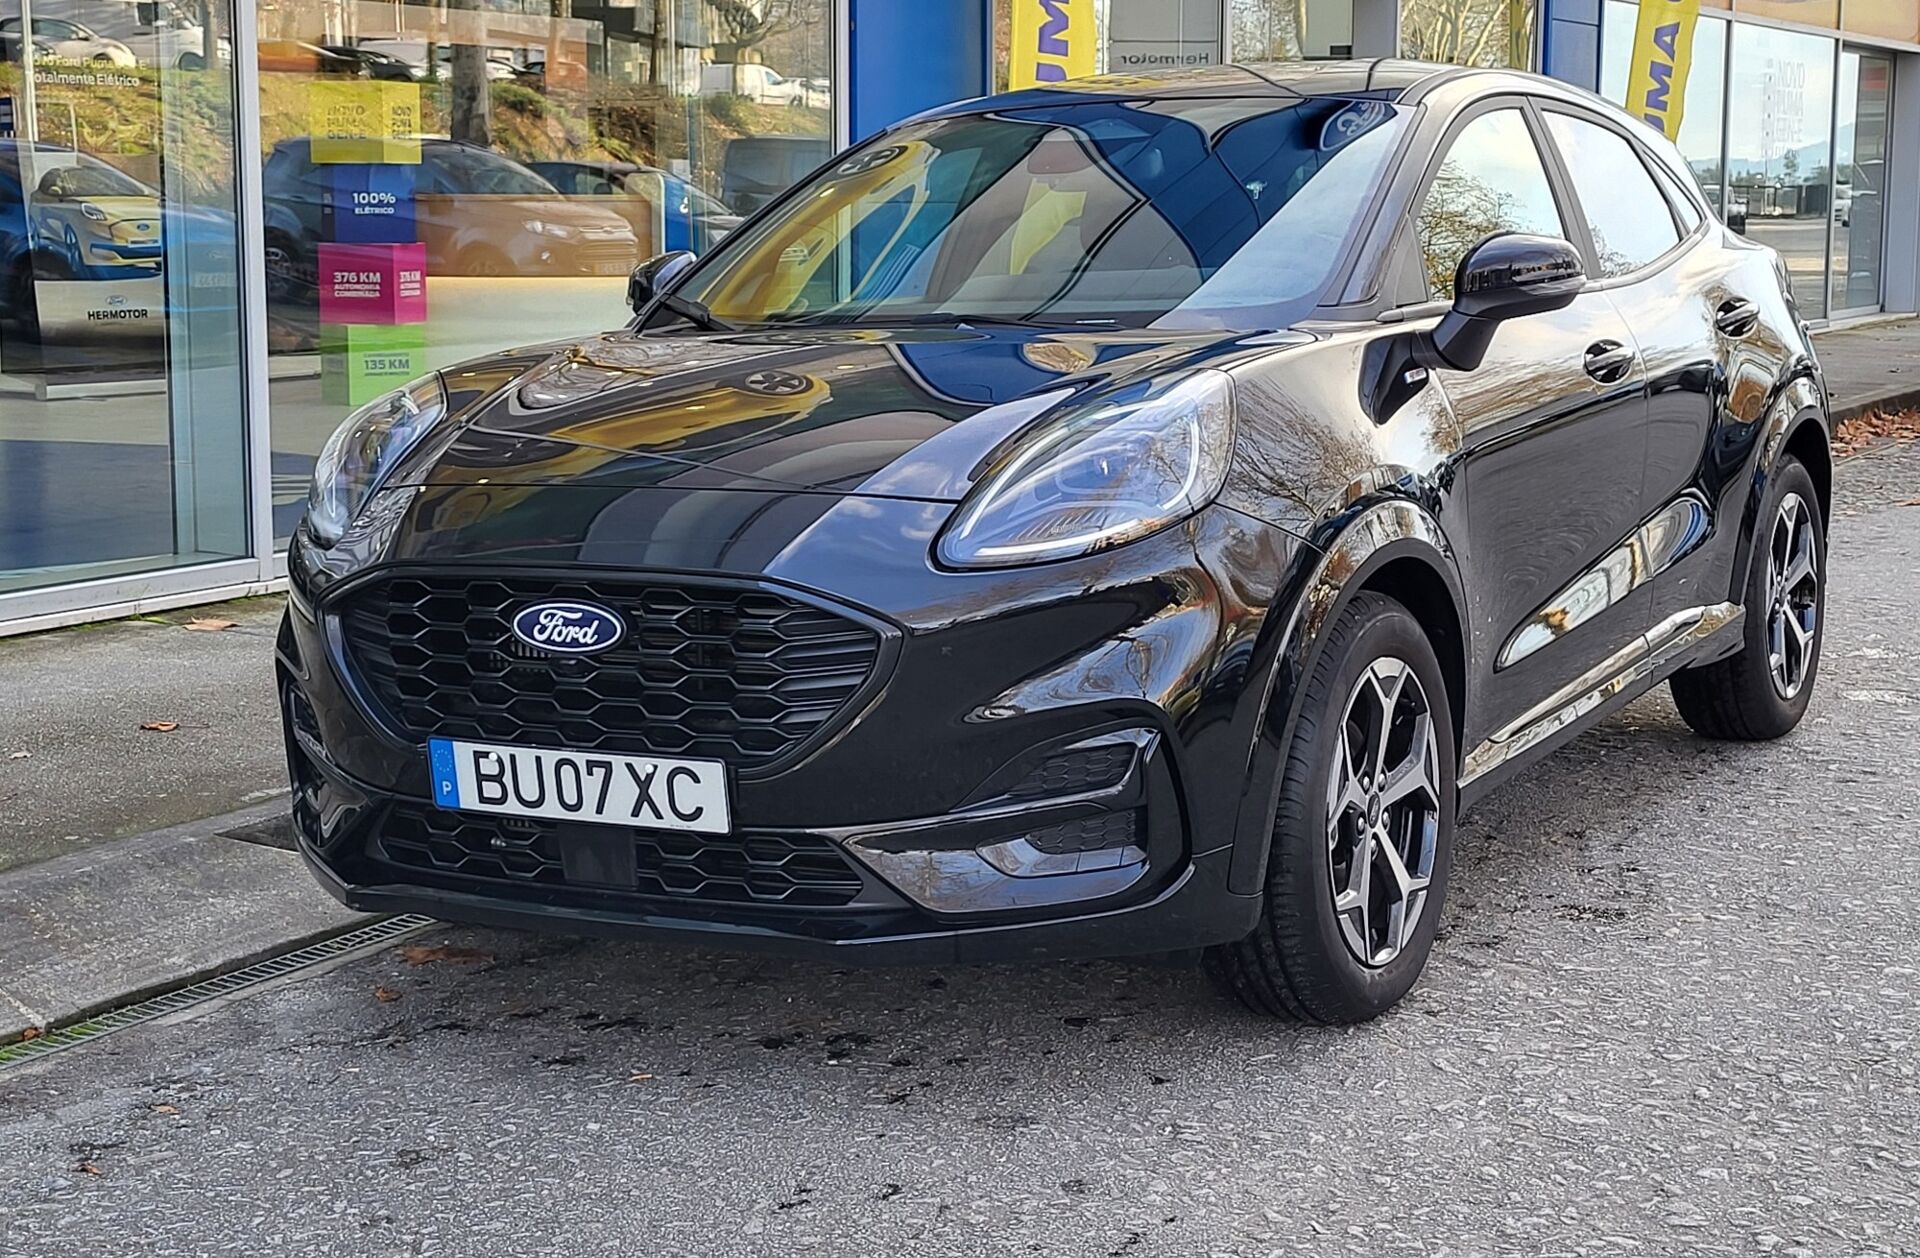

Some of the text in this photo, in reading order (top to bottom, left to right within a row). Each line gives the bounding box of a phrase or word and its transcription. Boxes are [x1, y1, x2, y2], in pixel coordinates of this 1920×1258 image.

[57, 55, 80, 67] Ford
[34, 71, 140, 86] otalmente Elétrico
[352, 192, 397, 204] 100%
[354, 205, 395, 215] ELÉTRICO
[333, 271, 381, 283] 376 KM
[87, 309, 148, 321] HERMOTOR
[364, 359, 410, 370] 135 KM
[533, 609, 600, 645] Ford
[442, 781, 452, 796] P
